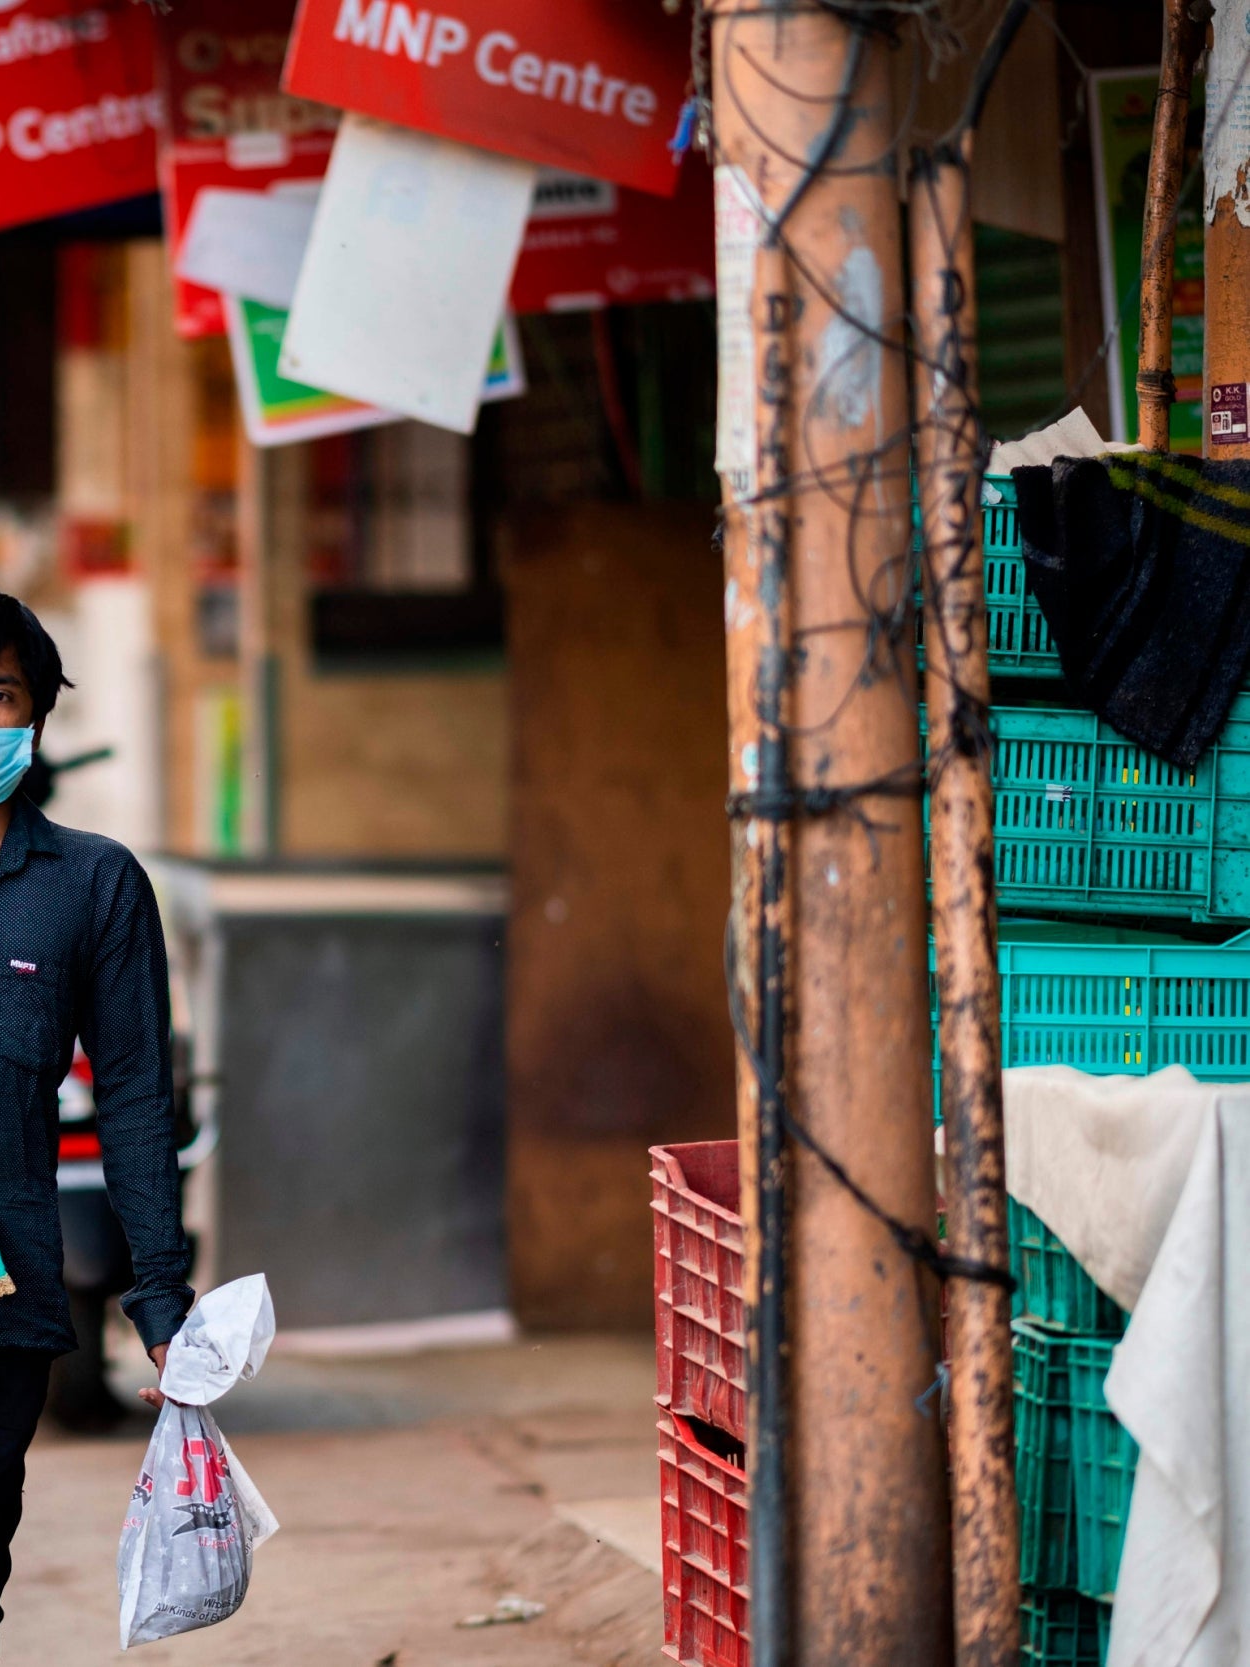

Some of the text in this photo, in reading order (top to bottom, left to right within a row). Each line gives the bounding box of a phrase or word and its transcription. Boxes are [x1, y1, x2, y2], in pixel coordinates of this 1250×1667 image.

[333, 0, 468, 67] MNP
[475, 29, 658, 126] Centre
[169, 1605, 197, 1619] Kinds
[198, 1611, 210, 1621] of
